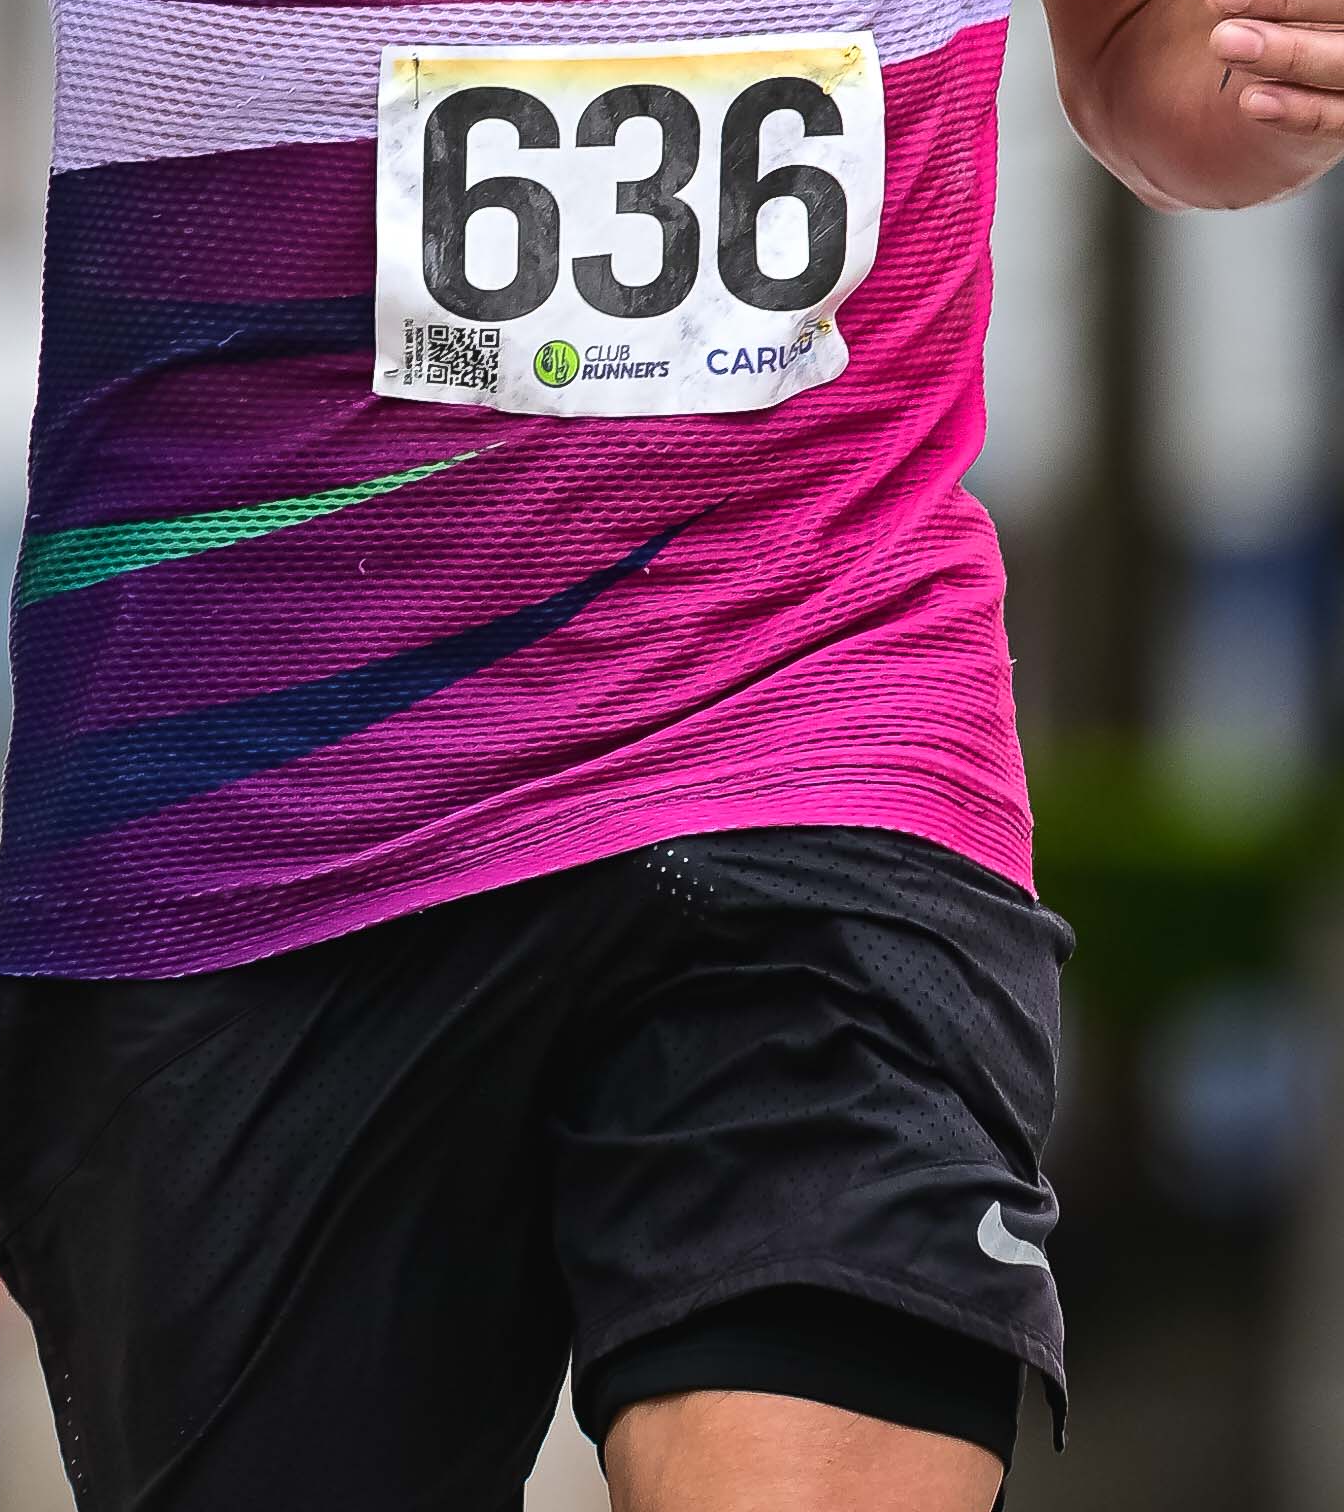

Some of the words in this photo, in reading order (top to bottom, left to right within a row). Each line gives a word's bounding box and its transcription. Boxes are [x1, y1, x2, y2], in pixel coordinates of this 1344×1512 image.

[422, 76, 848, 322] 636
[585, 344, 631, 362] CLUB
[581, 360, 670, 380] RUNNER'S
